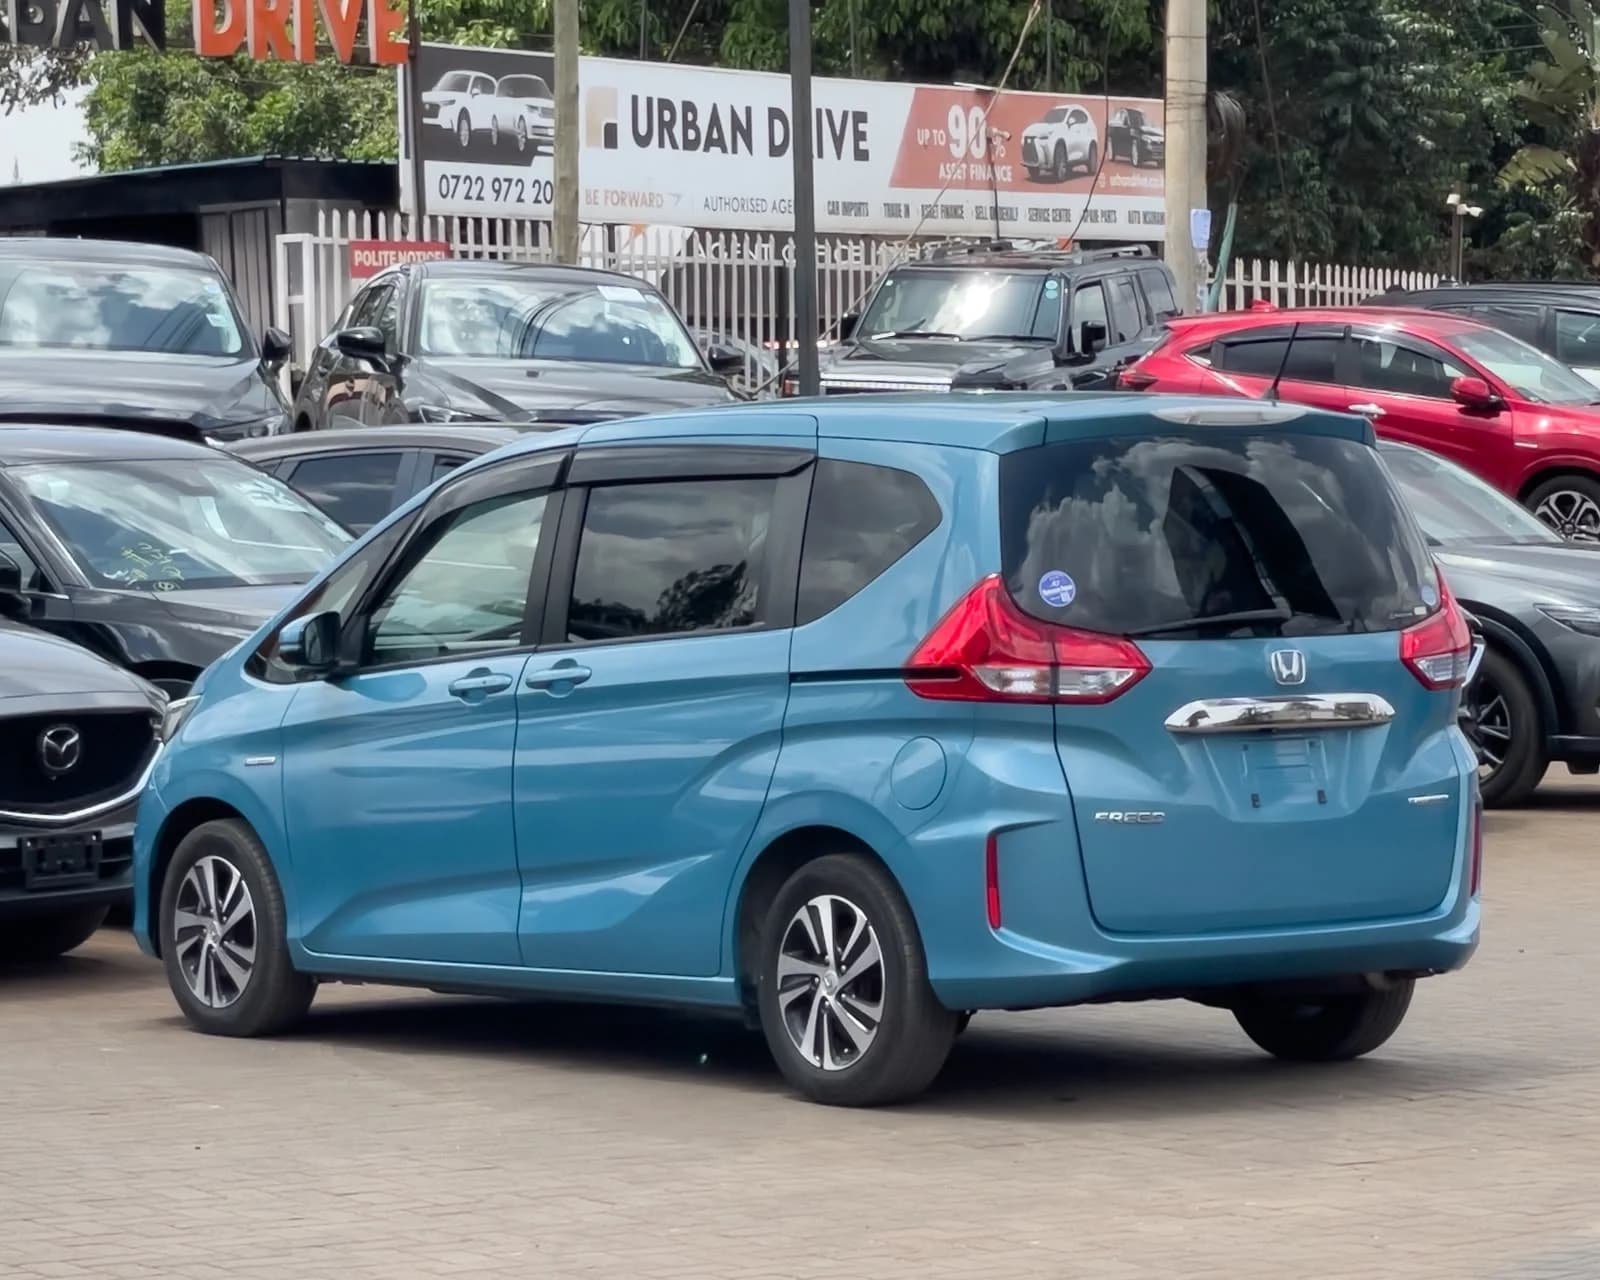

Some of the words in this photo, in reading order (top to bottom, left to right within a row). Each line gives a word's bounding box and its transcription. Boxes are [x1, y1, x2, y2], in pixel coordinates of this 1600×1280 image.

[0, 0, 166, 51] BAN
[193, 0, 411, 64] DRIVE
[631, 94, 753, 156] URBAN
[768, 107, 870, 162] DIVE
[917, 127, 930, 146] UP
[932, 129, 947, 146] TO
[939, 162, 967, 180] ASSET
[970, 163, 1013, 182] FINANCE
[438, 173, 485, 201] 0722
[491, 177, 525, 203] 972
[531, 179, 554, 205] 20
[585, 188, 600, 206] BE
[603, 189, 664, 208] FORWARD
[703, 194, 768, 213] AUTHORISED
[771, 198, 793, 215] AGE
[354, 249, 397, 267] POLITE
